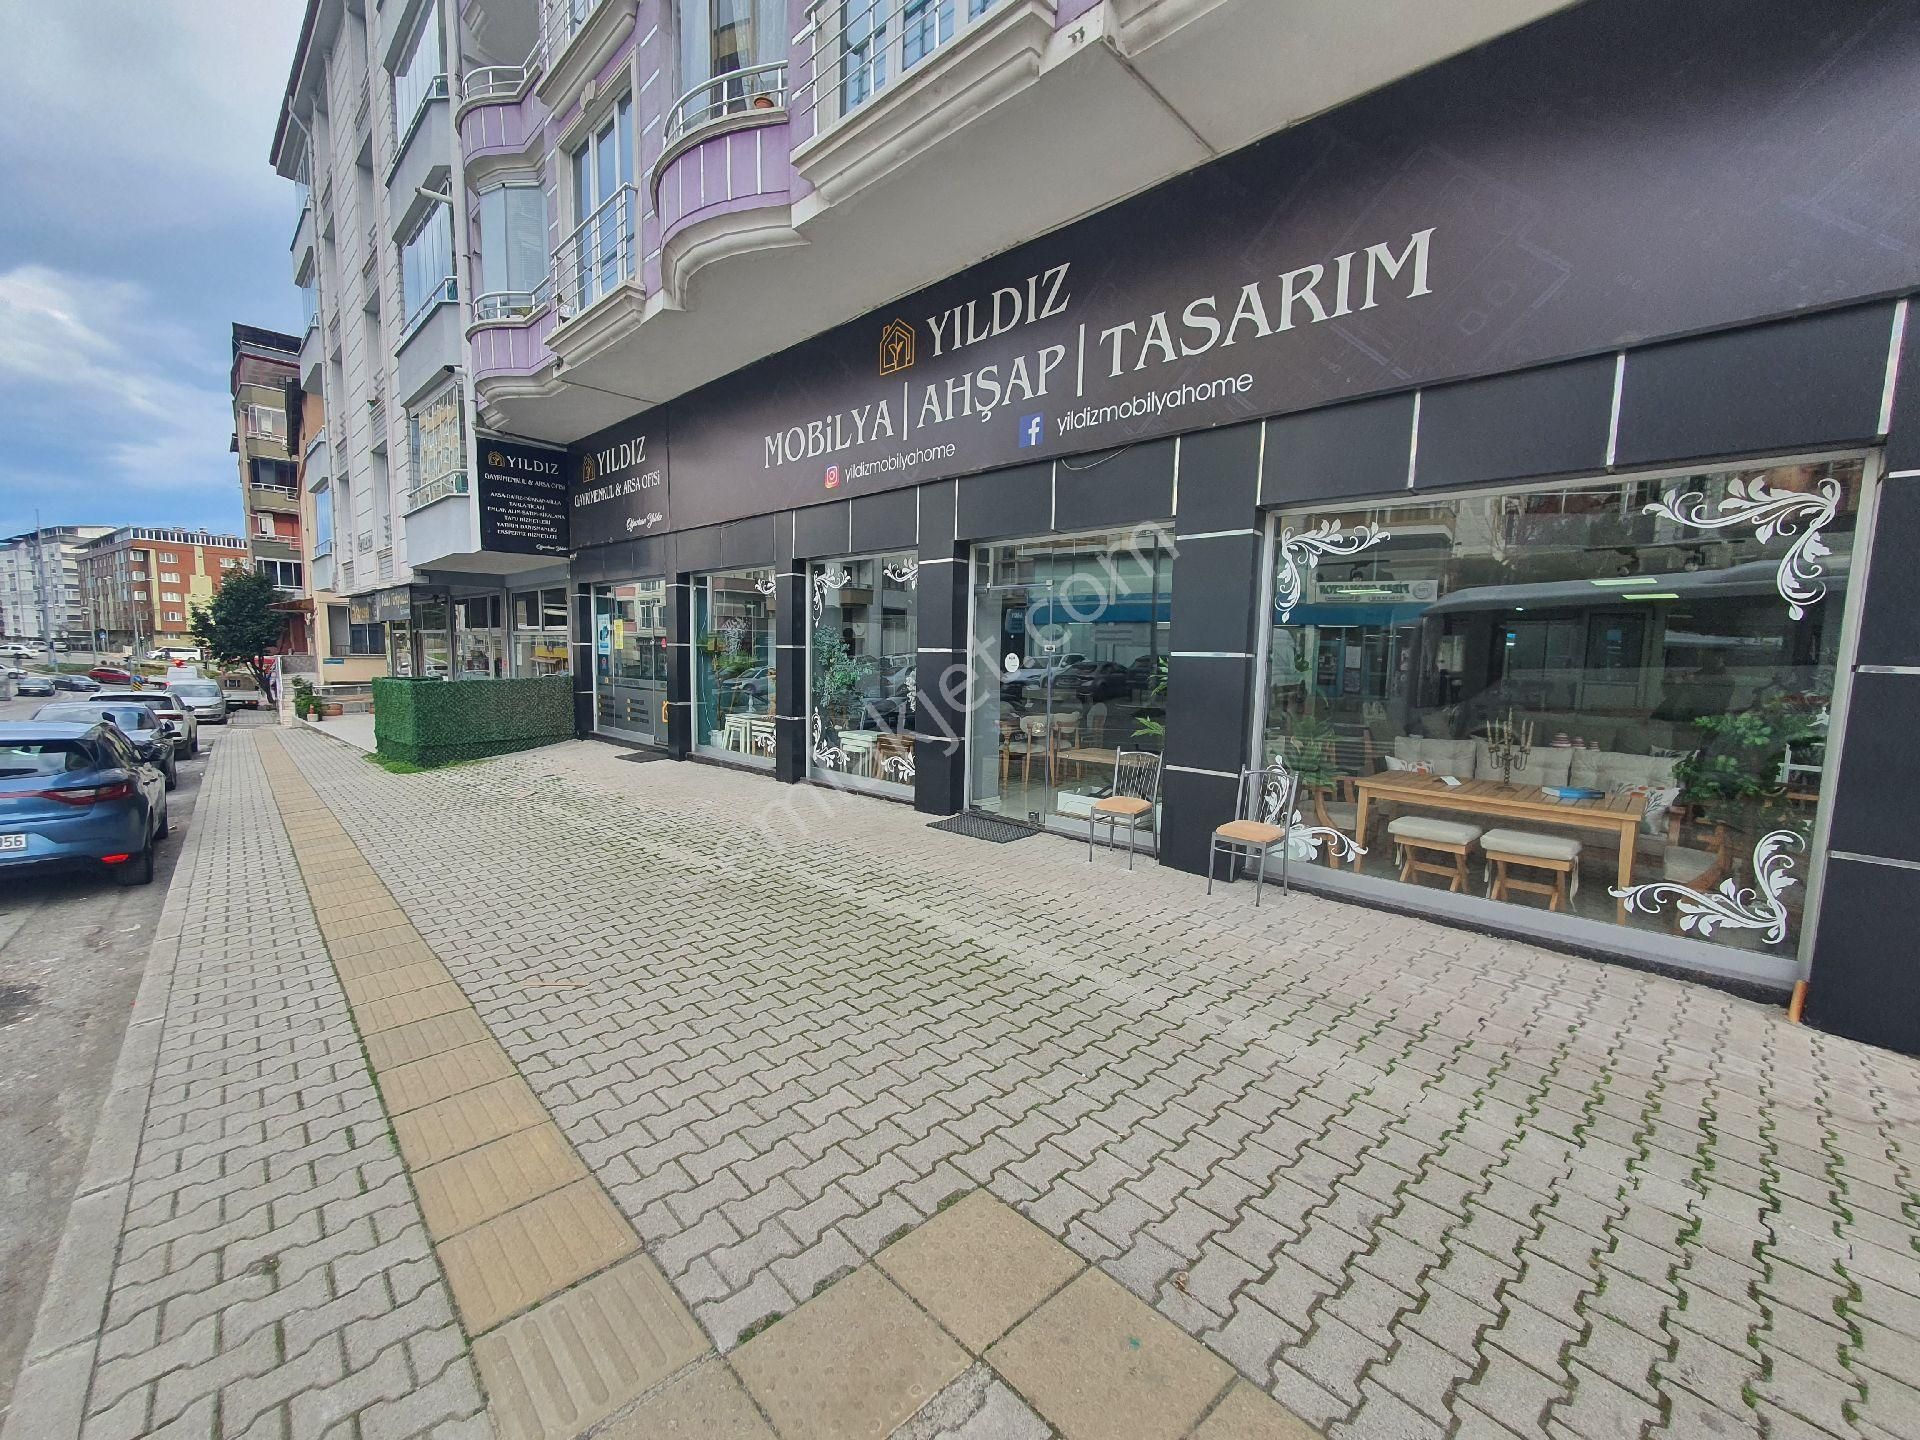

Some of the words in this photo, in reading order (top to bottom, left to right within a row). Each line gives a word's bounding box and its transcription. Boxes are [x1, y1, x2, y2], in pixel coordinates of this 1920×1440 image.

[917, 344, 1066, 423] AHŞAP
[1099, 227, 1437, 378] TASARIM
[926, 262, 1071, 357] YILDIZ
[1056, 373, 1254, 436] yildizmobilyahome
[506, 456, 559, 475] YILDIZ
[597, 435, 647, 476] YILDIZ
[845, 443, 956, 483] yildizmobilyahome
[534, 480, 549, 489] ARSA
[615, 482, 622, 495] &
[623, 477, 641, 495] ARSA
